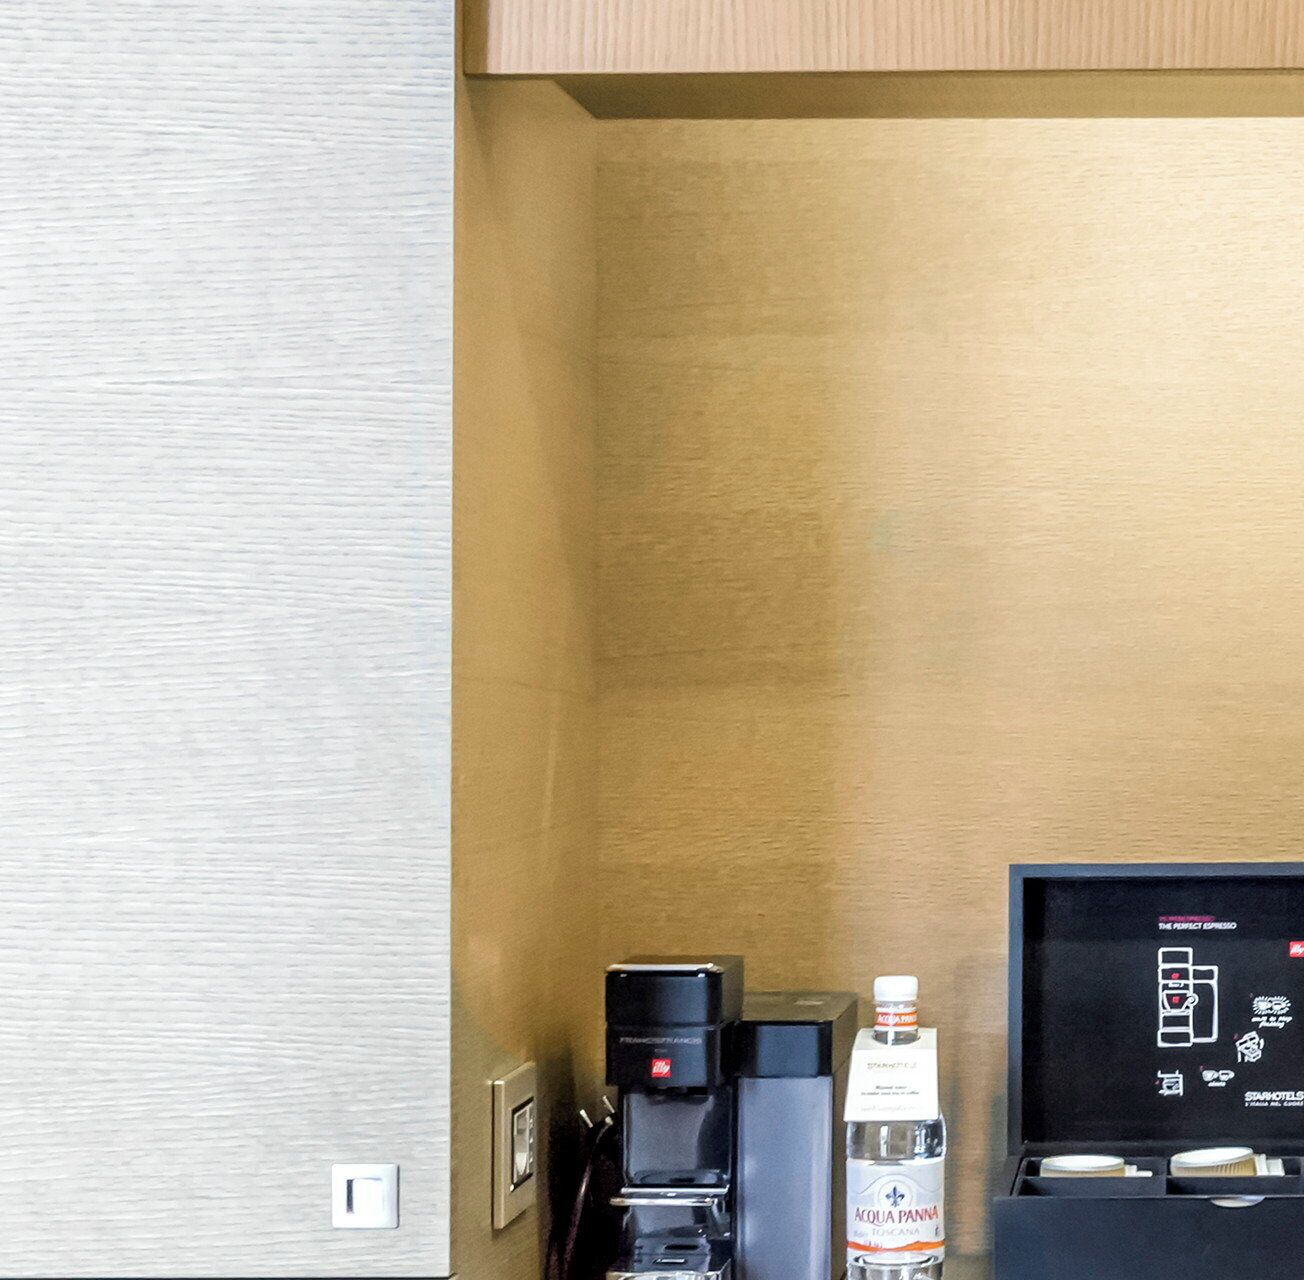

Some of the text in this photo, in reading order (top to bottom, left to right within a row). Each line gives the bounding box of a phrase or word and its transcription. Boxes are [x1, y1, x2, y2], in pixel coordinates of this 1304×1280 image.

[652, 1061, 671, 1075] illy
[855, 1205, 939, 1227] ACQUA PANNA
[872, 1227, 920, 1237] TOSCANA
